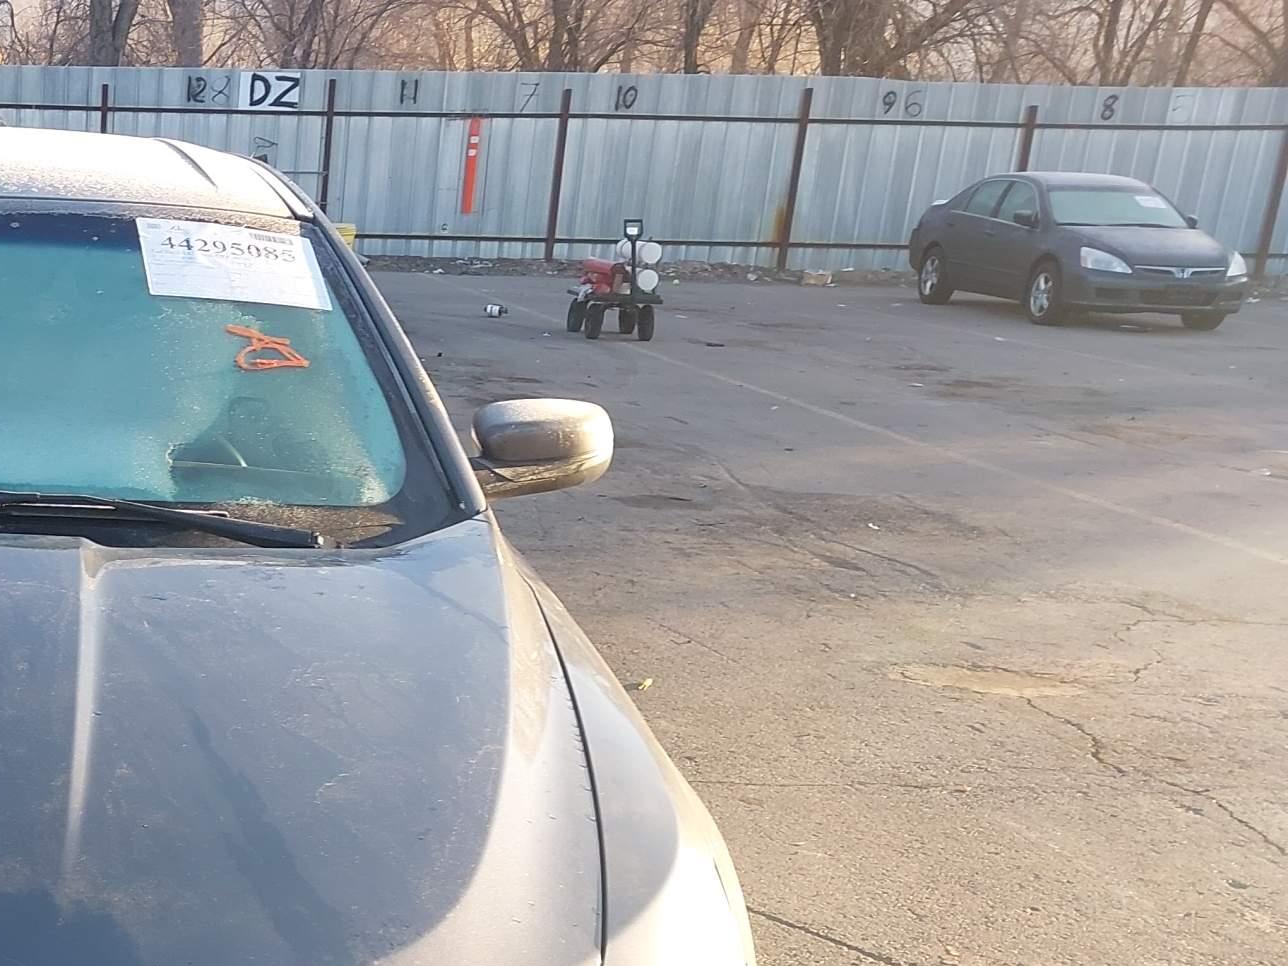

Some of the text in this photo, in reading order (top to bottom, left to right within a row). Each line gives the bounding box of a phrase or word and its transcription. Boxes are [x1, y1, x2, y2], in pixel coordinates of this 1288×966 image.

[248, 72, 301, 109] DZ
[520, 82, 540, 113] 7
[614, 84, 638, 112] 10
[1100, 93, 1119, 121] 8
[160, 236, 297, 263] 44295085
